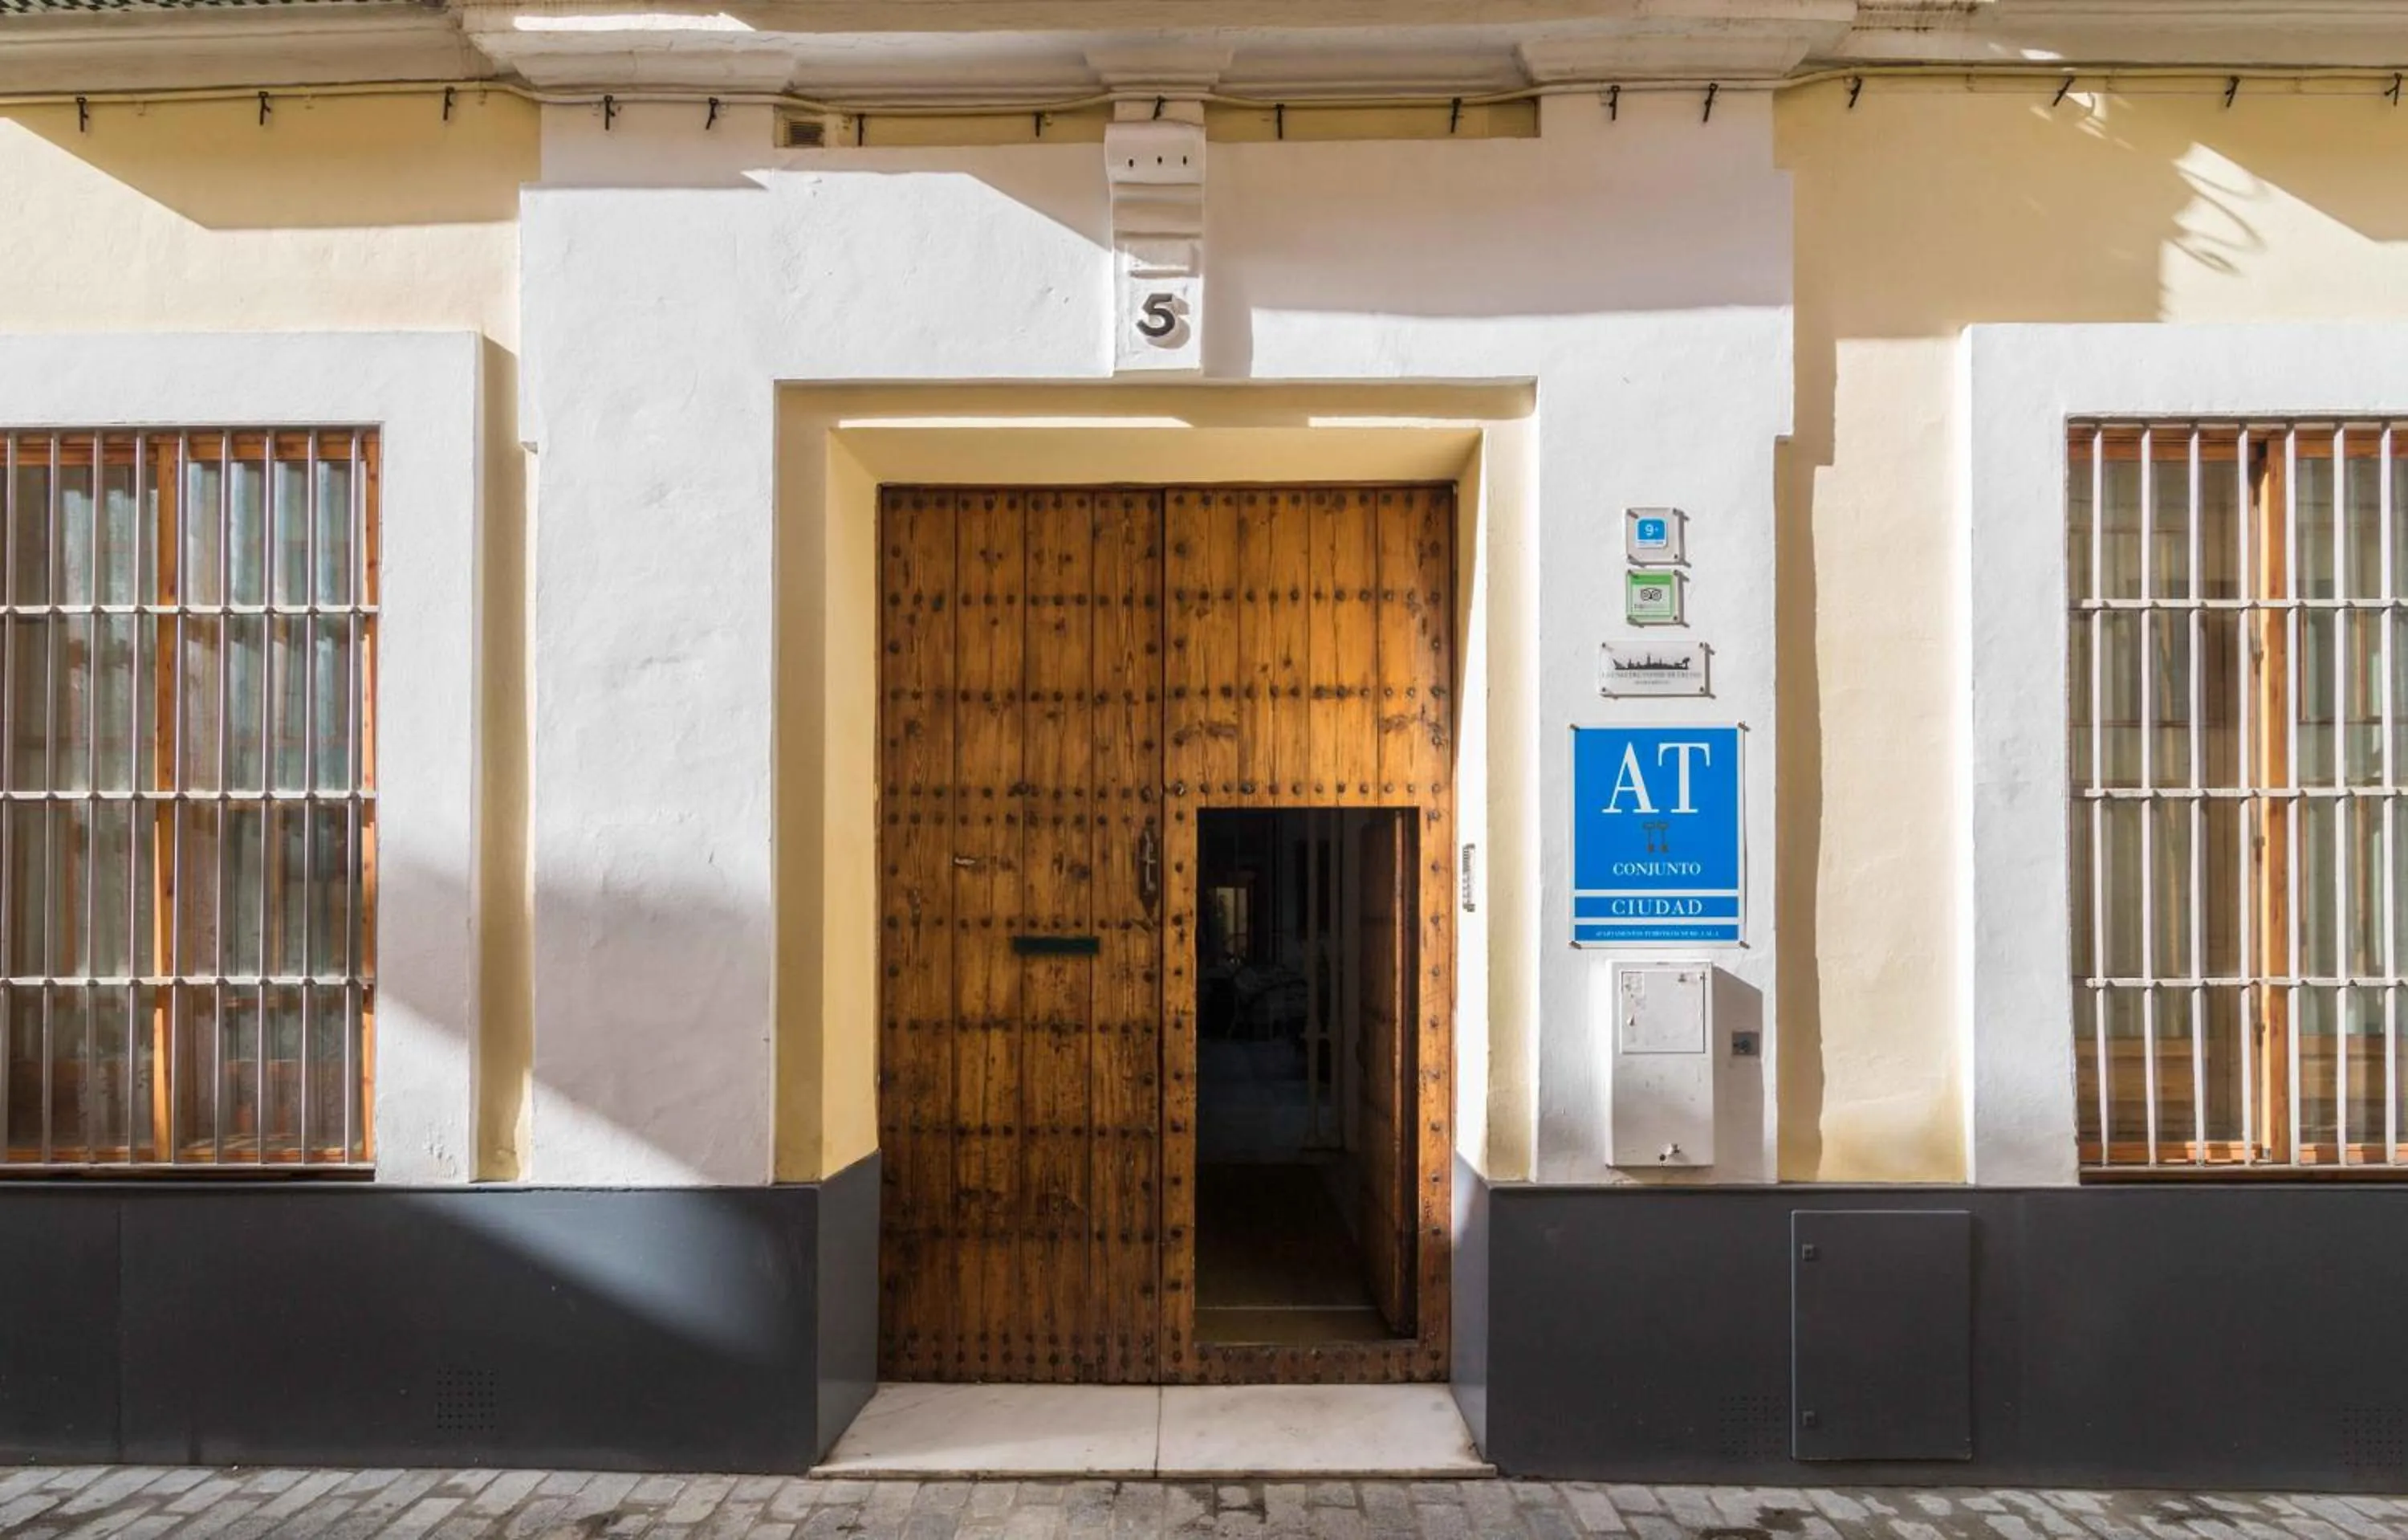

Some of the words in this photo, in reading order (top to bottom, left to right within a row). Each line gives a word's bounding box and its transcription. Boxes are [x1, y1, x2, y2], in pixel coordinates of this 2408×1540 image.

[1136, 293, 1176, 338] 5
[1601, 741, 1710, 814] AT
[1613, 862, 1702, 876] CONJUNTO
[1611, 898, 1703, 915] CIUDAD
